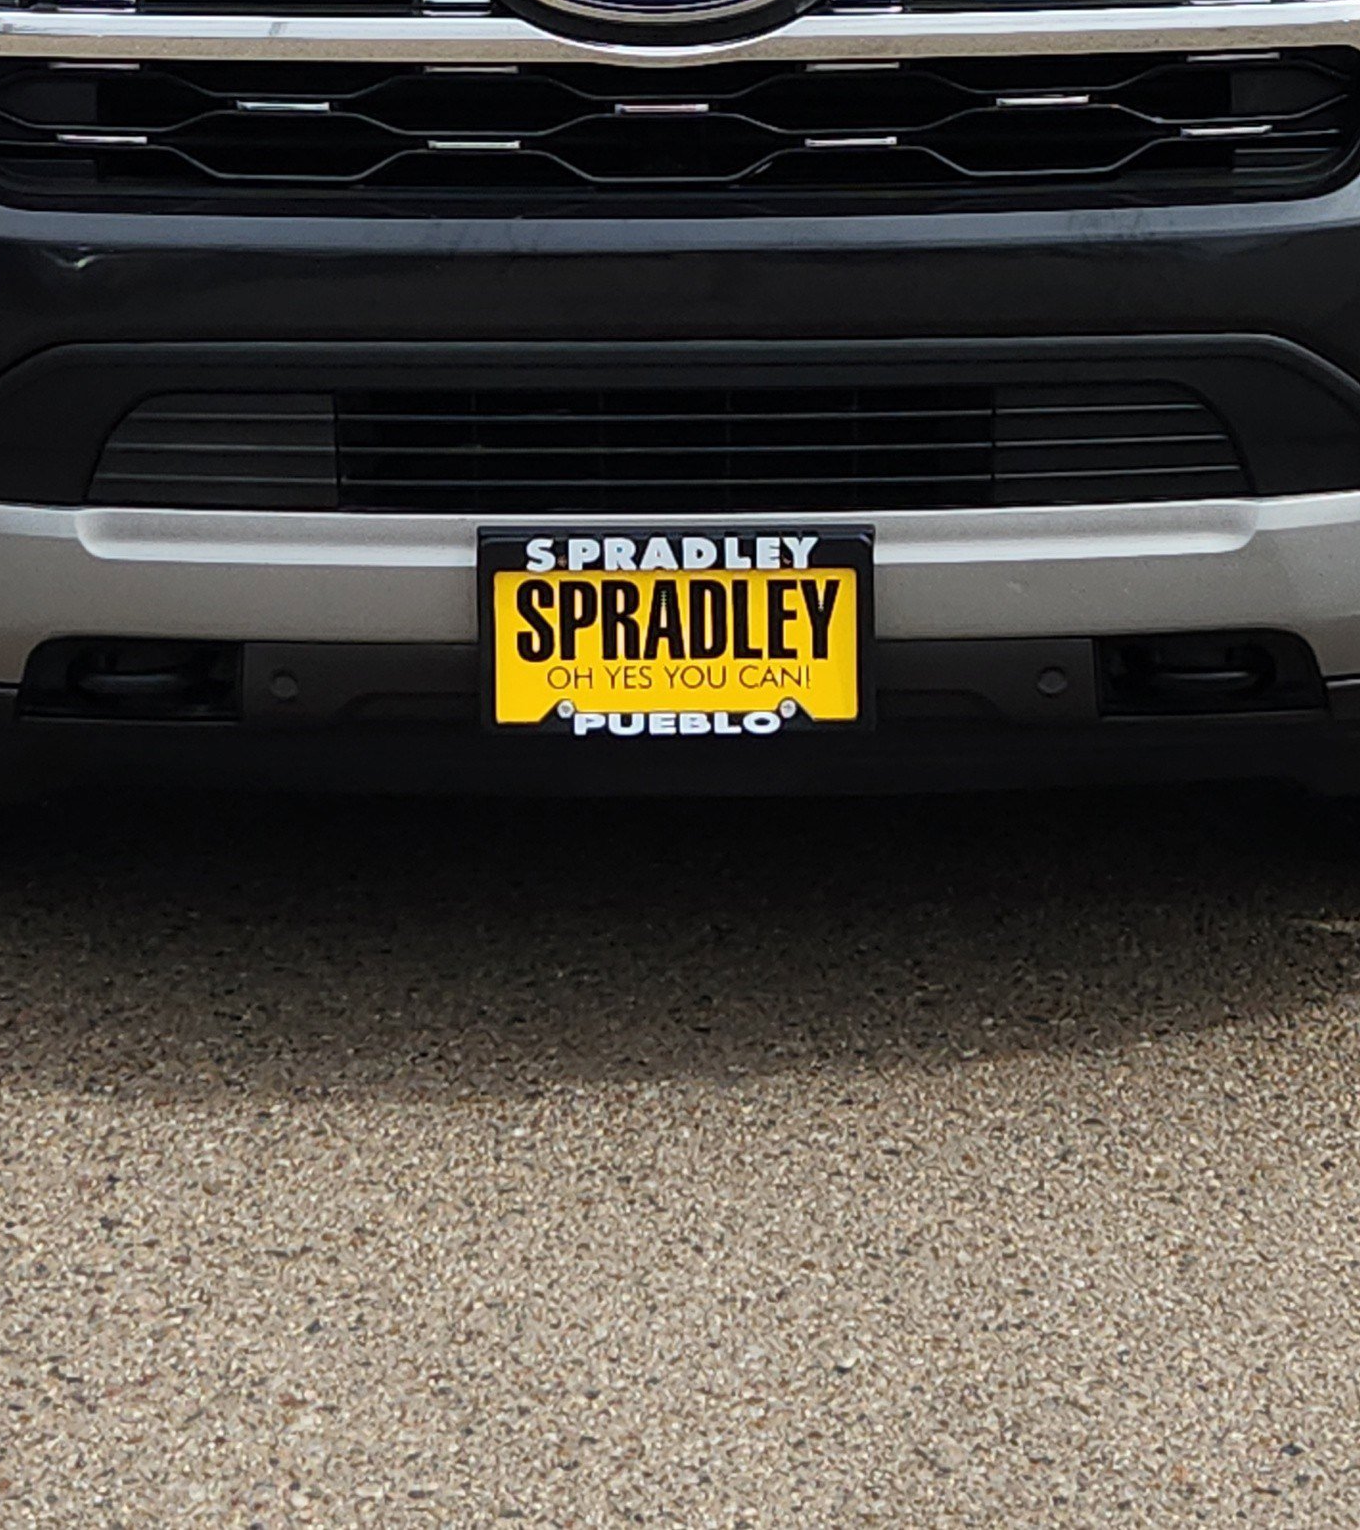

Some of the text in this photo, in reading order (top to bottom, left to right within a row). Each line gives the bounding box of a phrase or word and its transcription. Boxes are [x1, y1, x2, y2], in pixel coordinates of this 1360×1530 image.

[526, 536, 819, 572] SPRADLEY
[516, 579, 840, 662] SPRADLEY
[547, 665, 812, 690] OH YES YOU CAN!
[574, 712, 782, 737] PUEBLO
